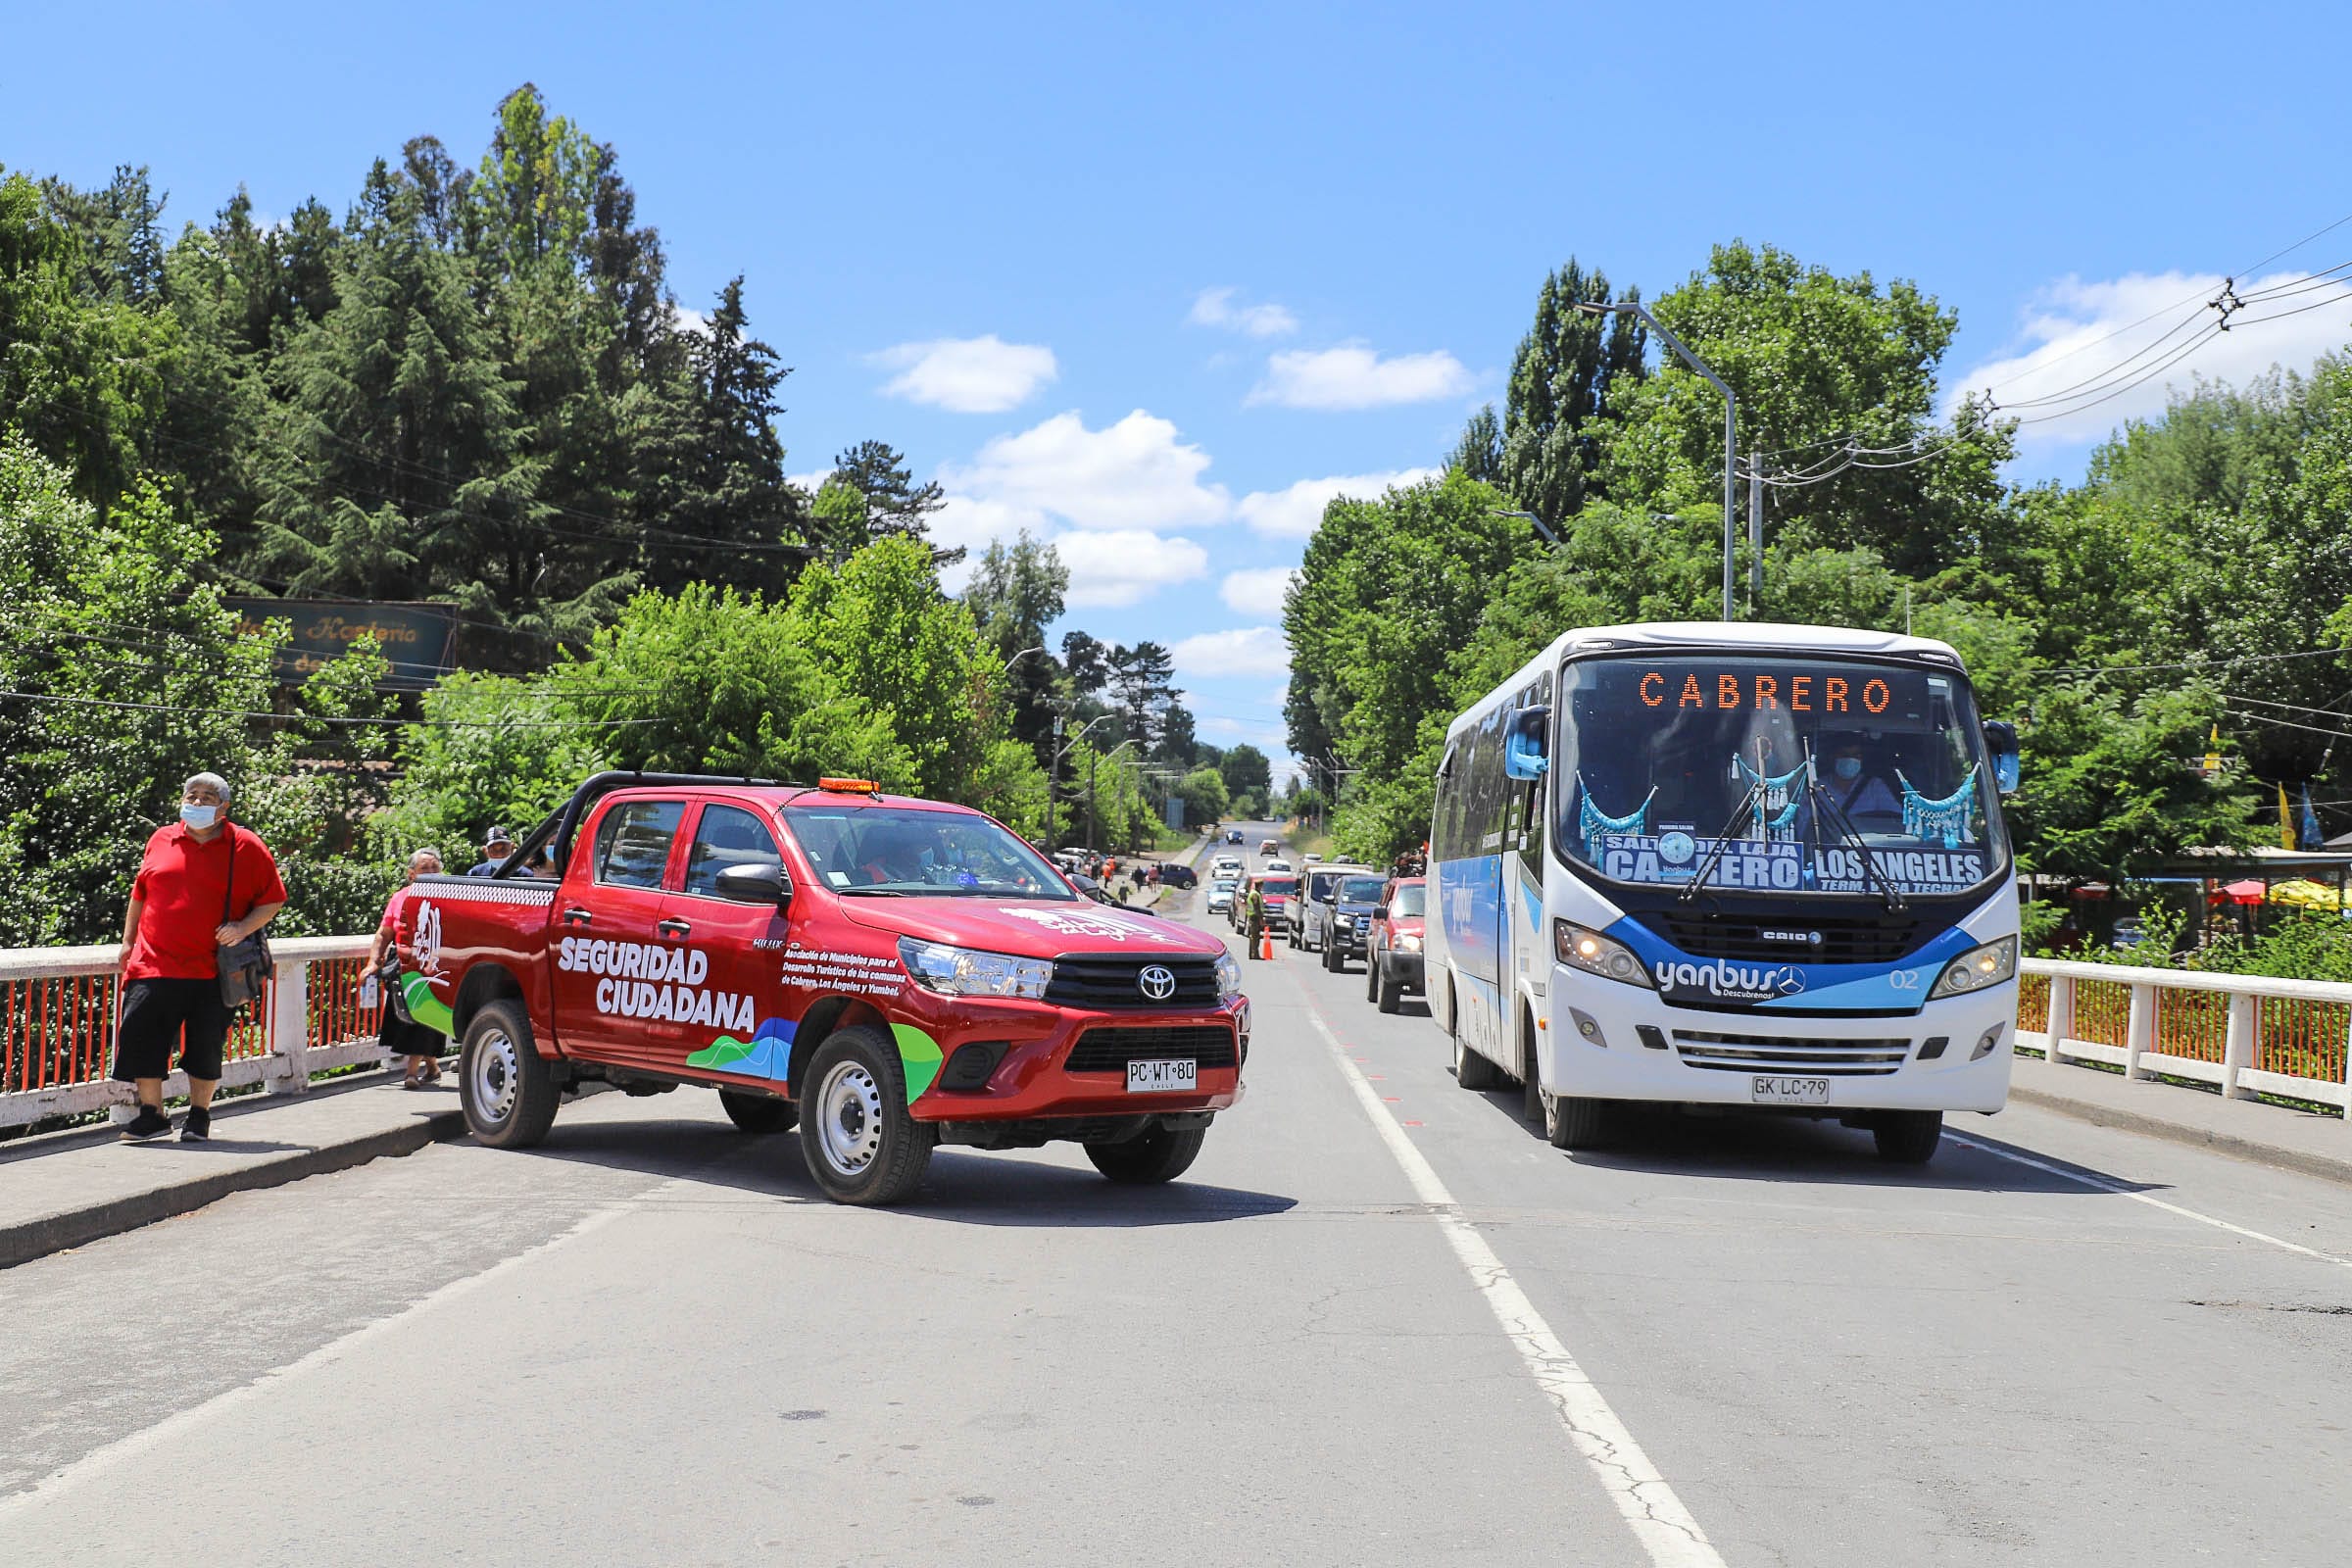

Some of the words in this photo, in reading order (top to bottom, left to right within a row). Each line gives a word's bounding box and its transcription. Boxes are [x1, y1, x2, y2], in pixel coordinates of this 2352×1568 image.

[1640, 672, 1890, 713] CABRERO
[1606, 836, 1659, 852] SALT
[1740, 842, 1798, 858] LAJA
[1606, 851, 1799, 889] CARERO
[1815, 849, 1864, 880] LOS
[1870, 851, 1983, 884] ANGELES
[558, 937, 709, 985] SEGURIDAD
[783, 962, 815, 973] Desarrollo
[816, 965, 847, 977] Turístico
[848, 968, 857, 978] de
[858, 969, 869, 979] las
[870, 972, 906, 983] comunas
[784, 949, 819, 960] Asociación
[819, 952, 828, 961] de
[829, 953, 868, 966] Municipios
[868, 957, 887, 968] para
[888, 958, 898, 968] el
[782, 975, 790, 985] de
[791, 976, 817, 988] Cabrero,
[819, 978, 831, 989] Los
[832, 978, 860, 994] Ángeles
[860, 984, 867, 994] y
[868, 984, 900, 997] Yumbel.
[1656, 958, 1777, 997] yanbus
[1889, 969, 1919, 990] 02
[596, 977, 755, 1034] CIUDADANA
